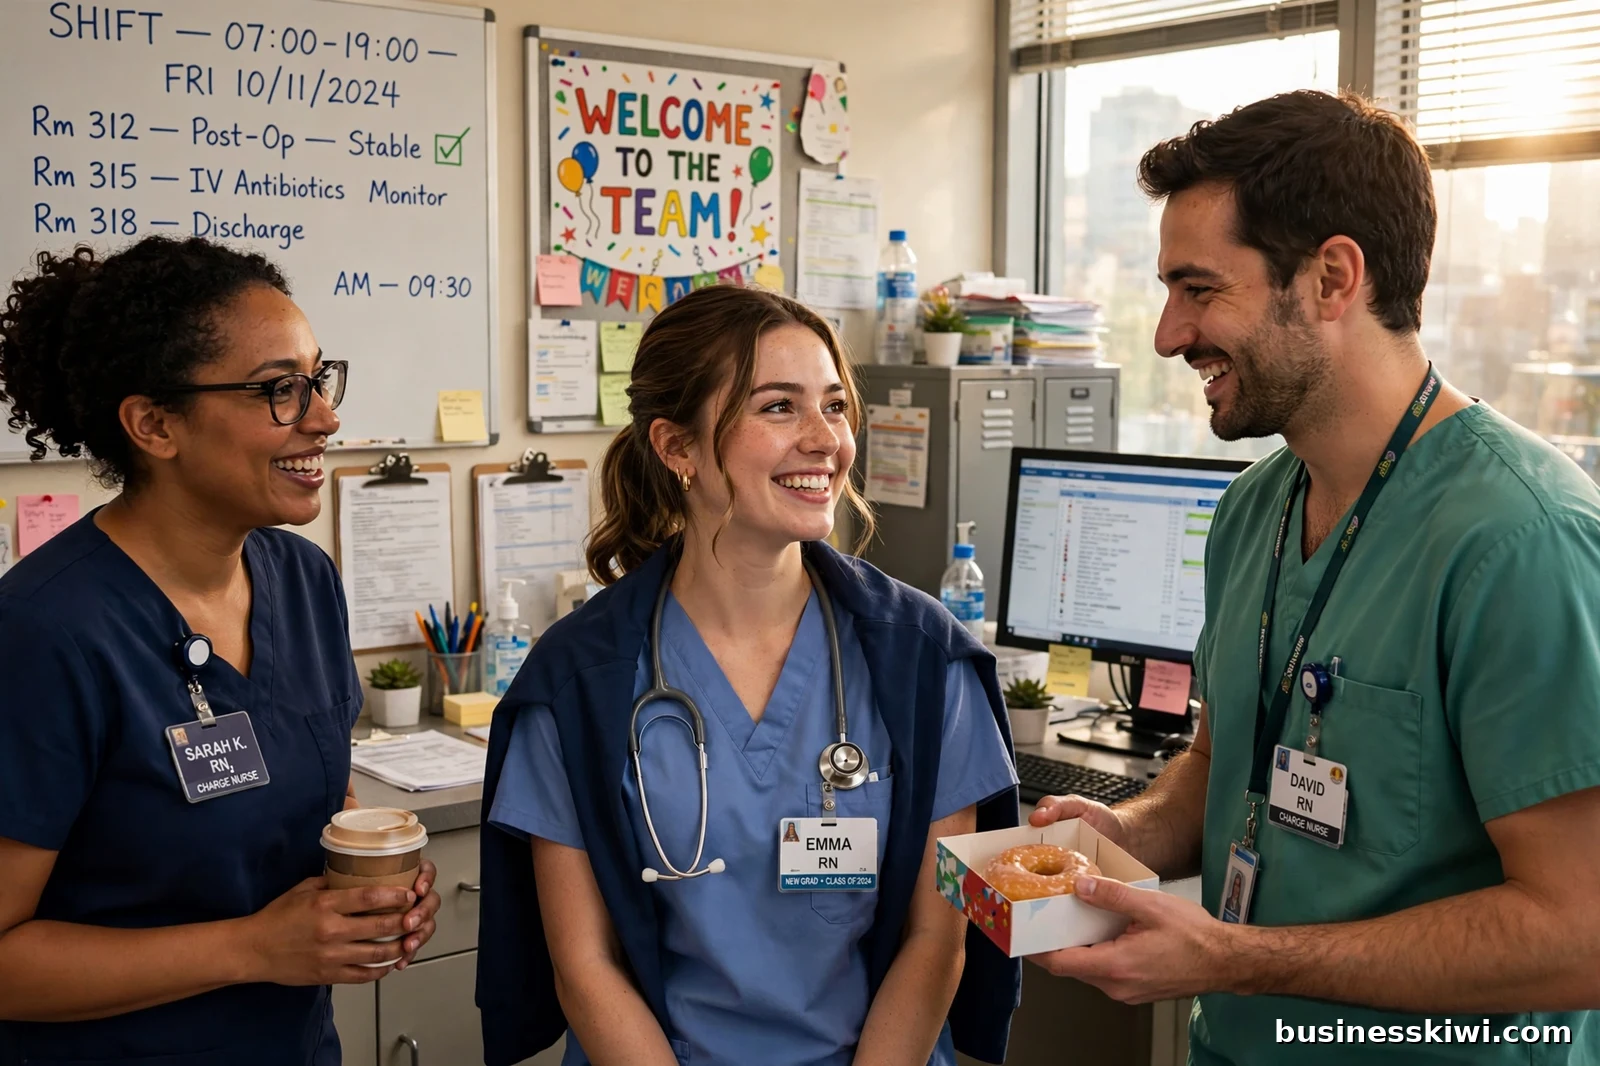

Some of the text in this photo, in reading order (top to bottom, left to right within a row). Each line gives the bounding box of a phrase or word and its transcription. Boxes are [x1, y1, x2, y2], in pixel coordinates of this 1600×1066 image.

[49, 2, 163, 45] SHIFT
[165, 63, 401, 108] FRI 10/11/2024
[575, 88, 752, 146] WELCOME
[33, 105, 74, 137] Rm
[89, 111, 139, 140] 312
[192, 116, 294, 160] Post-Op
[349, 130, 422, 159] Stable
[615, 147, 720, 182] TO THE
[34, 156, 75, 188] Rm
[90, 161, 137, 189] 315
[190, 168, 223, 194] IV
[234, 169, 345, 200] Antibiotics
[369, 180, 448, 207] Monitor
[34, 203, 76, 234] Rm
[90, 207, 137, 236] 318
[192, 211, 305, 250] Discharge
[600, 186, 742, 242] TEAM!
[334, 271, 371, 297] AM
[408, 274, 471, 298] 09:30
[184, 736, 247, 761] SARAH K.
[197, 770, 259, 793] CHARGE NURSE
[1290, 773, 1325, 796] DAVID
[1297, 796, 1313, 813] RN
[1279, 811, 1329, 837] CHARGE NURSE
[806, 837, 852, 851] EMMA
[818, 857, 838, 869] RN
[785, 877, 800, 886] NEW
[800, 877, 818, 886] GRAD
[825, 876, 846, 886] CLASS
[847, 876, 856, 885] OF
